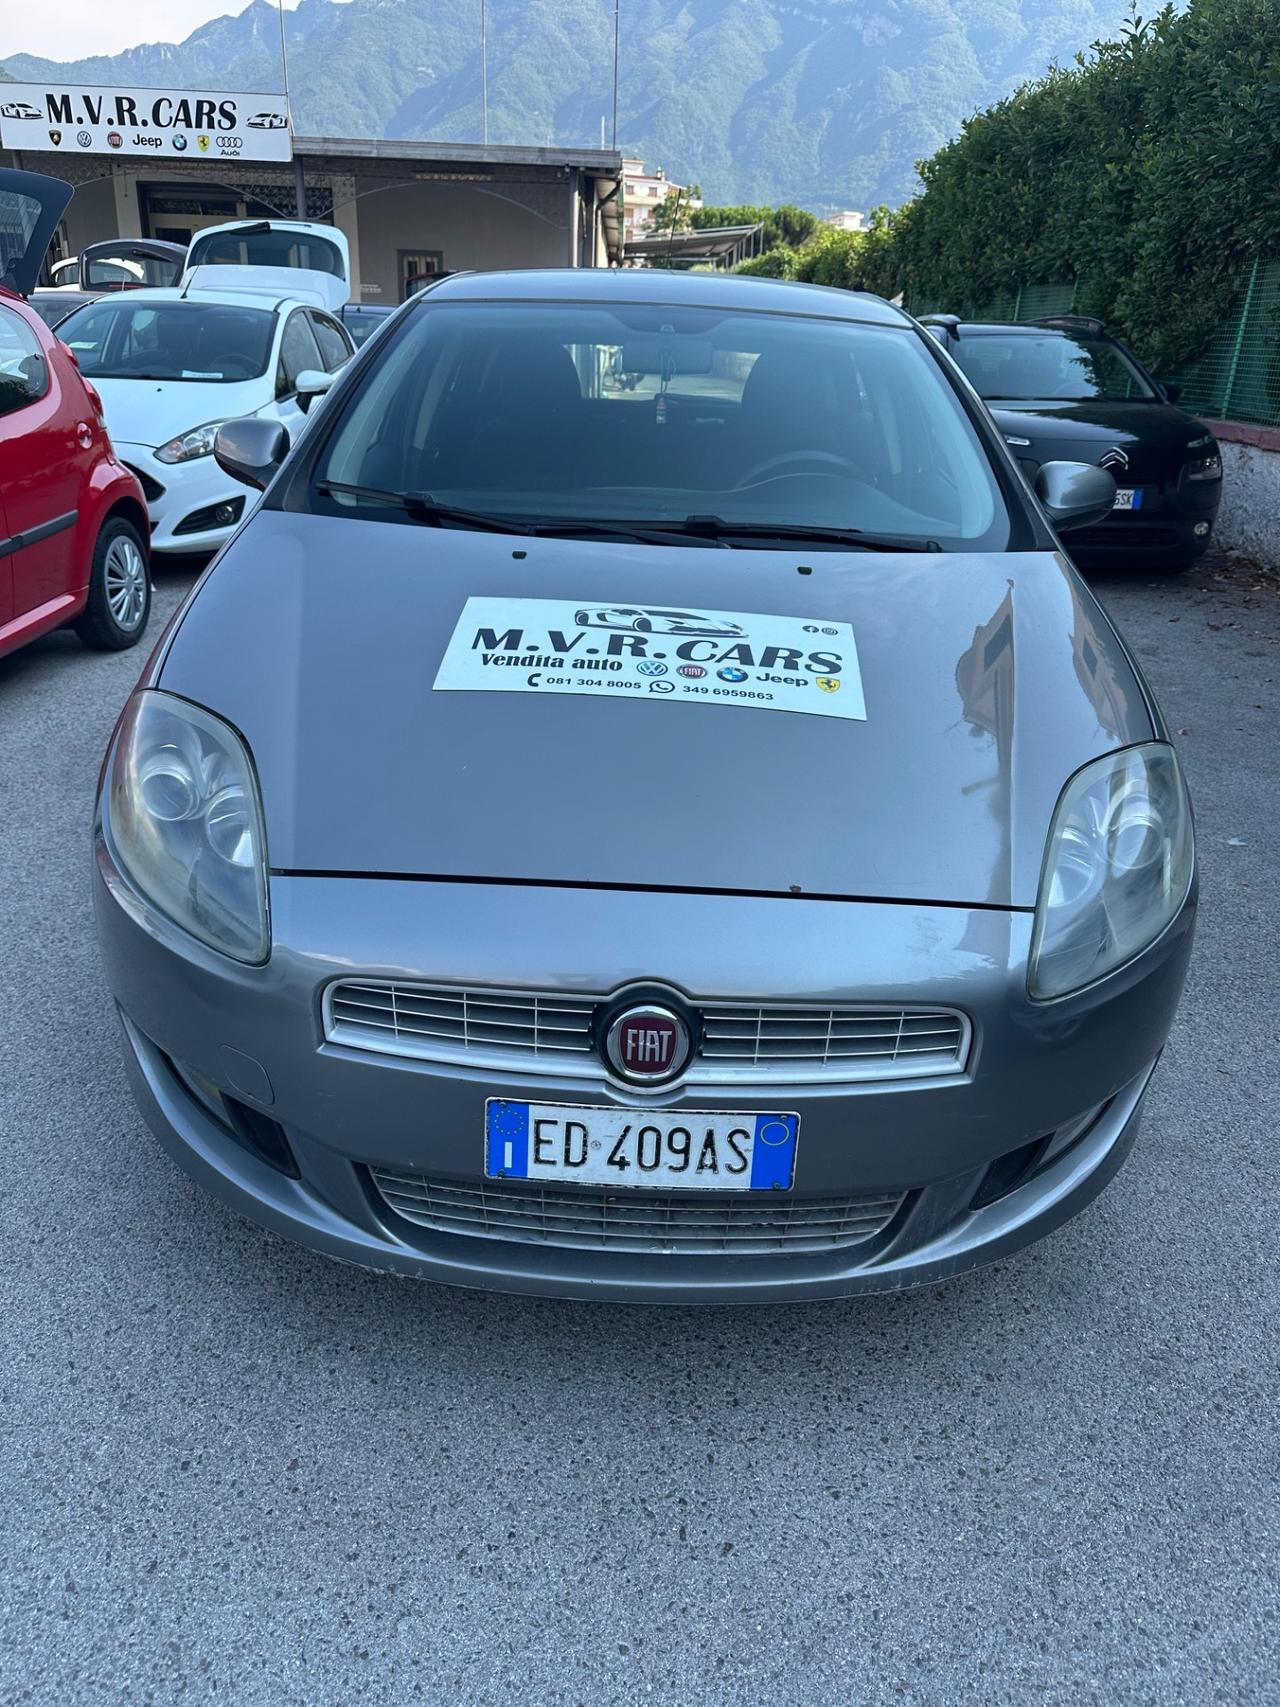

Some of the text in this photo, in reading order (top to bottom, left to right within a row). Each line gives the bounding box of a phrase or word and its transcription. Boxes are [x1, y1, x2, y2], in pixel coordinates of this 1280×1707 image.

[132, 133, 163, 148] Jeep
[220, 149, 240, 157] Audi
[481, 652, 564, 669] Vendita
[571, 655, 623, 671] auto
[755, 672, 809, 688] Jeep
[546, 675, 775, 701] 081 304 8005 349 6959863
[626, 1028, 672, 1062] FIAT
[533, 1118, 588, 1168] ED
[606, 1124, 752, 1175] 409AS
